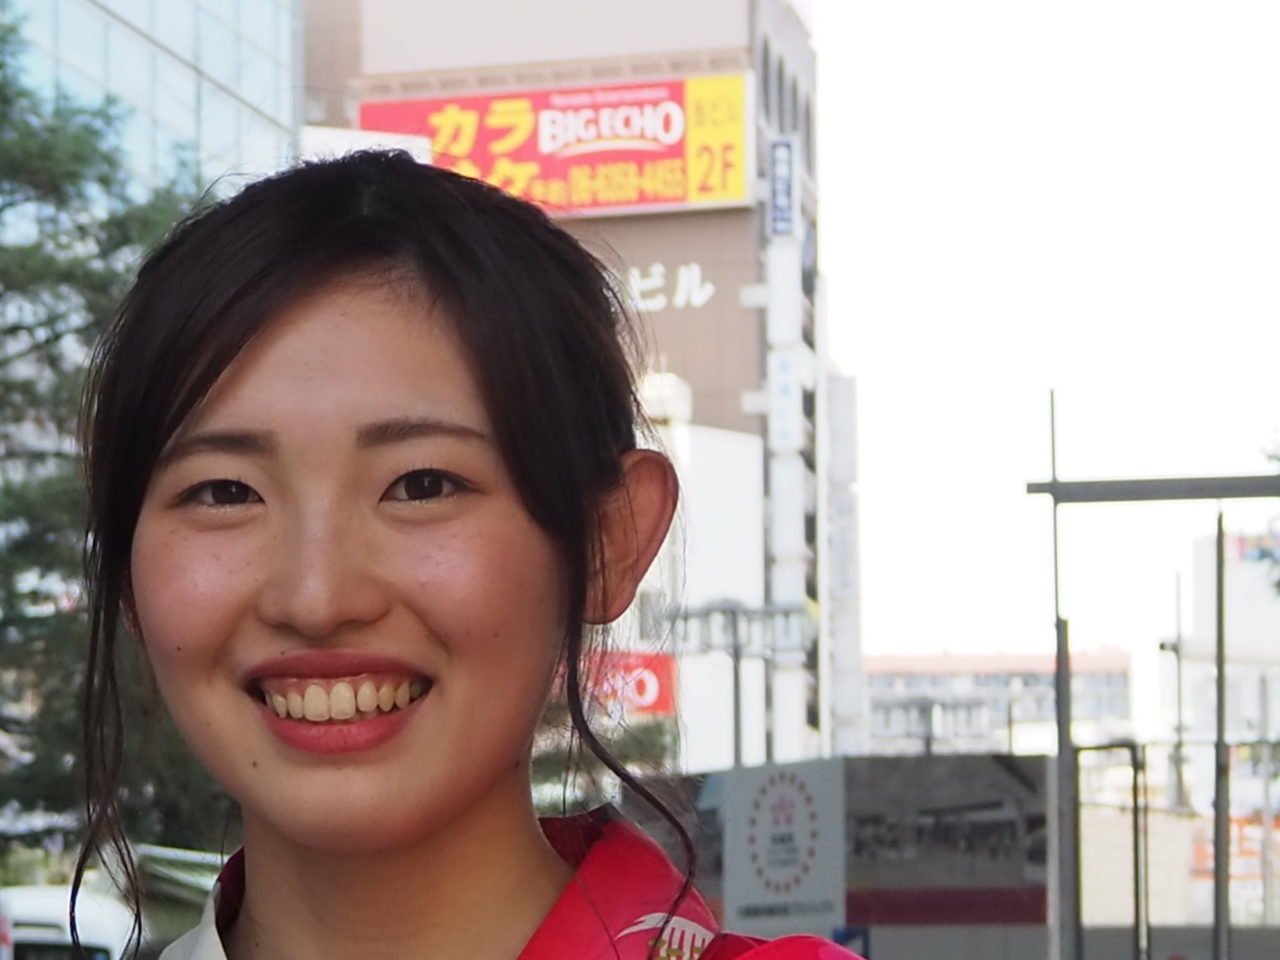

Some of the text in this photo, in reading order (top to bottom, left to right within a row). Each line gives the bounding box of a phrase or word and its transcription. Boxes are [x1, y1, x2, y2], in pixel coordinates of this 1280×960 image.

[428, 98, 535, 158] カラ
[538, 107, 597, 155] BIG
[599, 101, 685, 146] ECHO
[696, 144, 736, 194] 2F
[628, 262, 715, 312] ビル
